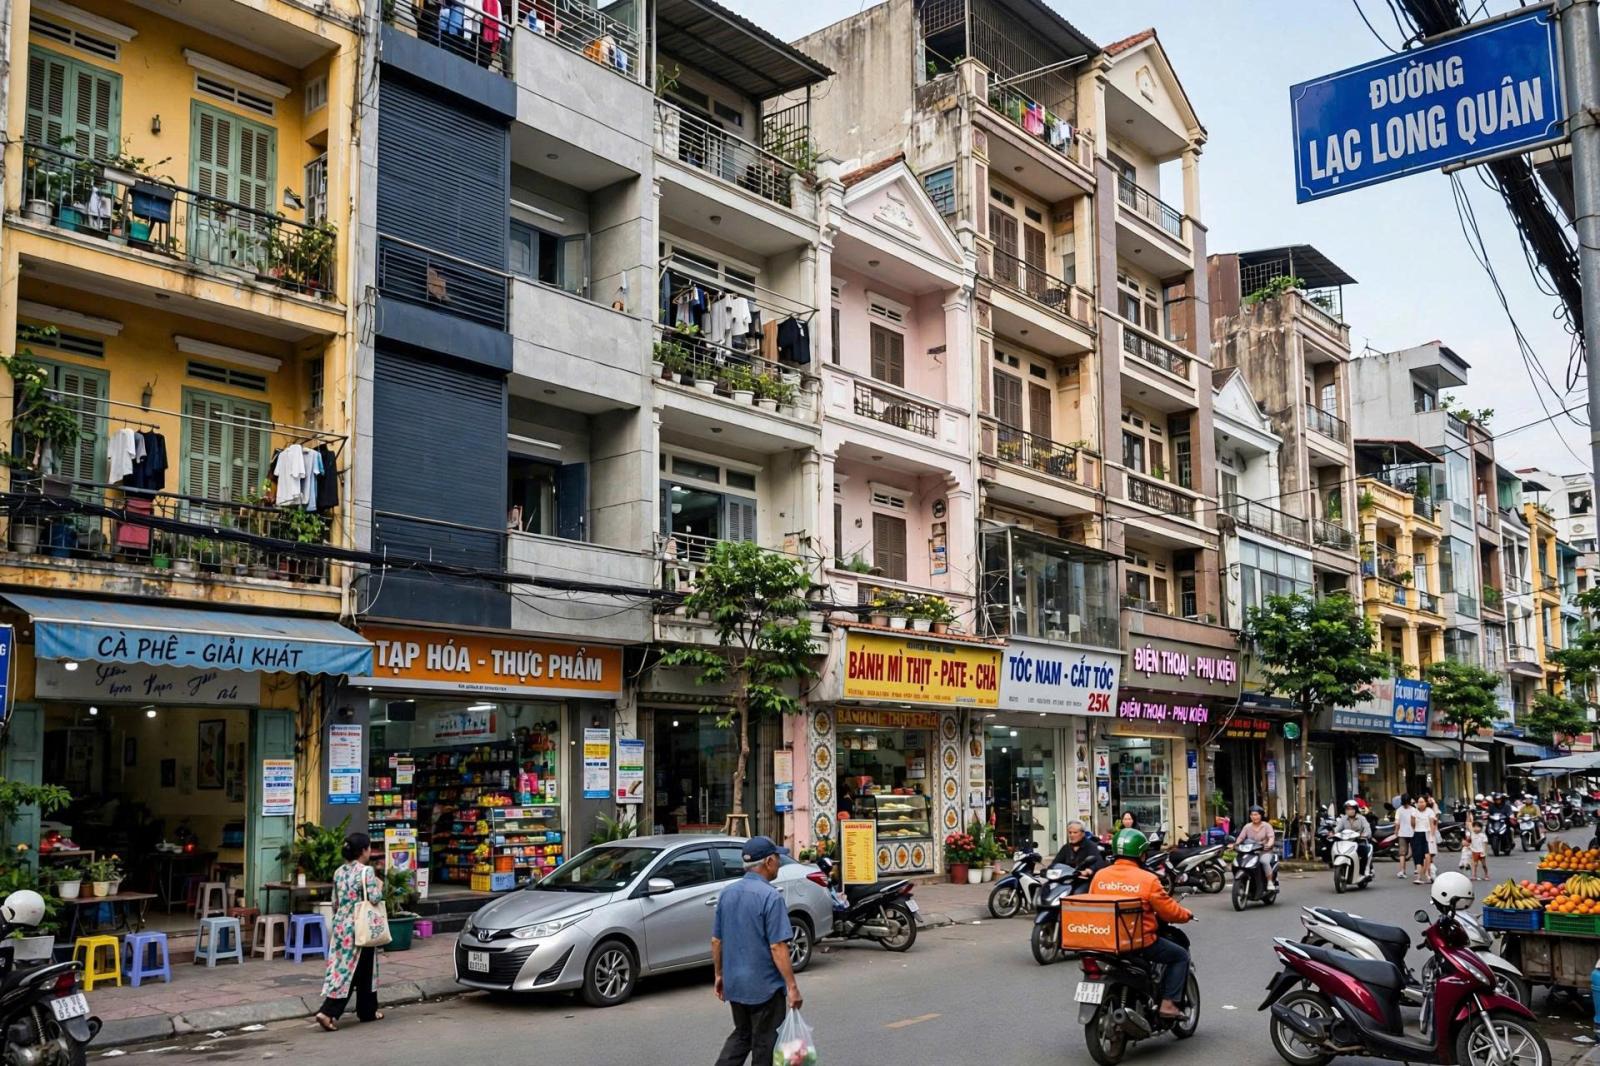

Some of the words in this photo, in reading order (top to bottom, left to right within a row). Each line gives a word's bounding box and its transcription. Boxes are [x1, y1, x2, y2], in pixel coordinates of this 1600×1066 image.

[1369, 55, 1464, 110] ĐƯỜNG
[1309, 128, 1362, 184] LẠC
[1370, 105, 1446, 164] LONG
[1457, 75, 1544, 145] QUÂN
[97, 631, 128, 658] CÀ
[138, 635, 179, 661] PHÊ
[202, 636, 243, 666] GIẢI
[252, 640, 303, 668] KHÁT
[375, 640, 421, 675] TẠP
[426, 639, 472, 673] HÓA
[491, 649, 543, 683] THỰC
[548, 647, 602, 681] PHẨM
[848, 645, 884, 681] BÁNH
[887, 648, 904, 683] MÌ
[906, 656, 932, 691] THỊT
[940, 660, 967, 688] PATE
[975, 657, 997, 691] CHẢ
[1134, 642, 1158, 679] ĐIỆN
[1161, 651, 1189, 682] THOẠI
[1196, 656, 1216, 685] PHỤ
[1216, 655, 1237, 687] KIỆN
[1009, 650, 1033, 683] TÓC
[1035, 660, 1061, 686] NAM
[1071, 654, 1091, 688] CẮT
[1093, 660, 1114, 690] TÓC
[1087, 692, 1111, 713] 25K
[1119, 697, 1140, 722] ĐIỆN
[1142, 703, 1166, 724] THOẠI
[1172, 705, 1188, 725] PHỤ
[1188, 703, 1209, 727] KIỆN
[1098, 881, 1140, 893] GrabFood
[1067, 923, 1111, 935] GrabFood
